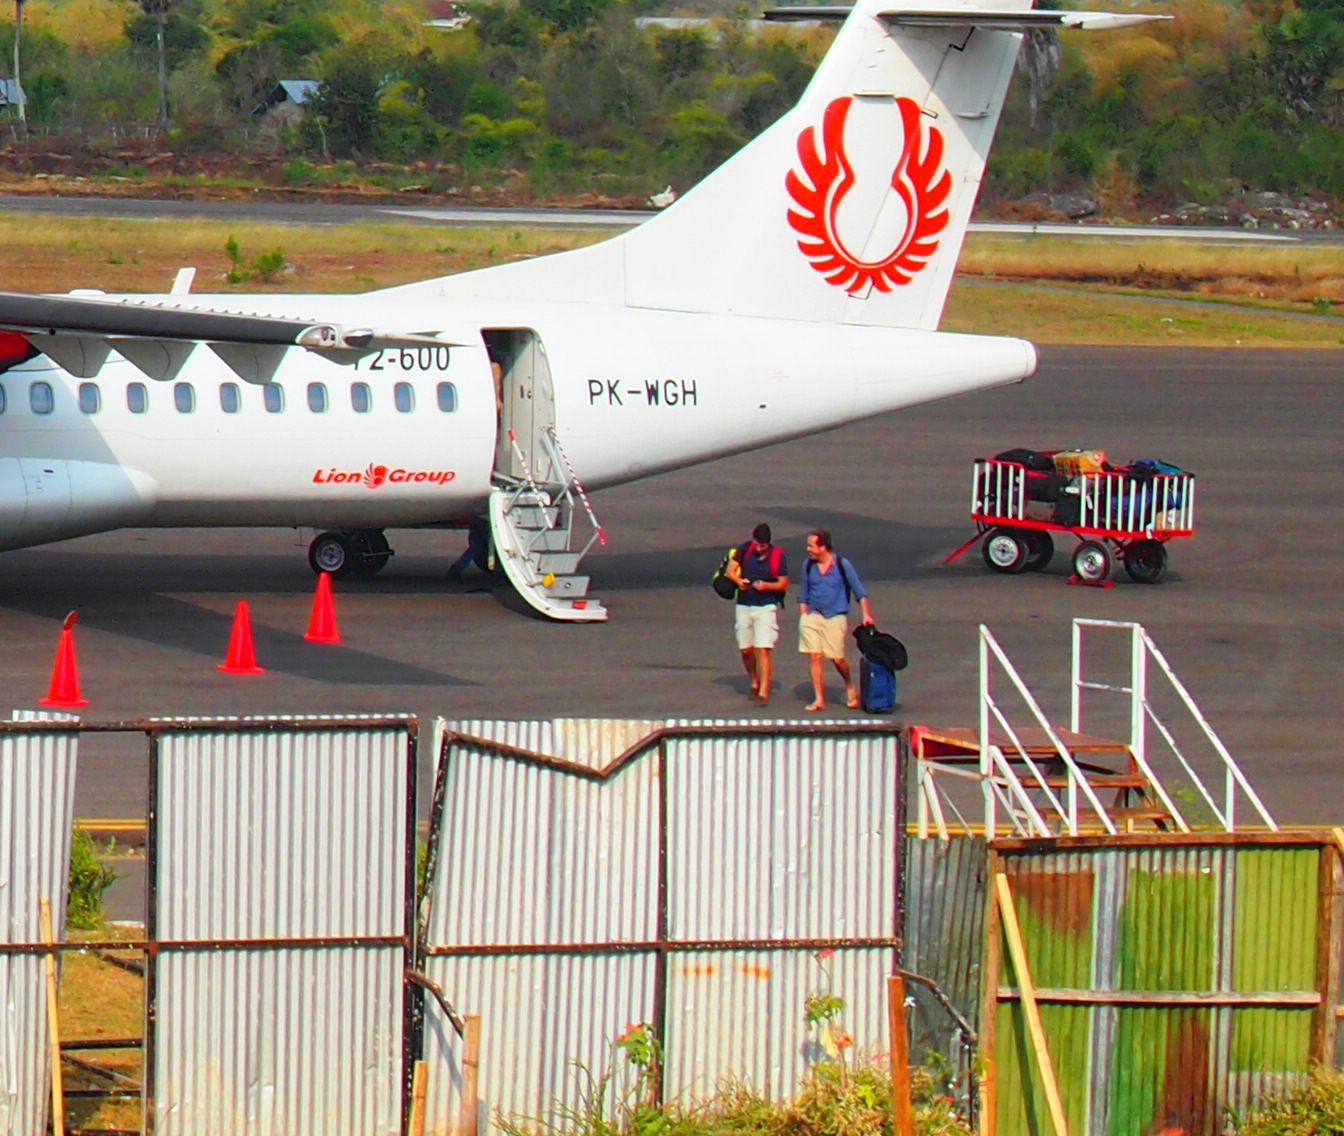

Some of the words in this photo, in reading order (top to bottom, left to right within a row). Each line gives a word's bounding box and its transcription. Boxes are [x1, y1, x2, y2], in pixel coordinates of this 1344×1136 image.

[354, 347, 450, 371] 2-600
[587, 379, 697, 406] PK-WGH
[312, 468, 362, 483] Lion
[388, 469, 456, 485] Group
